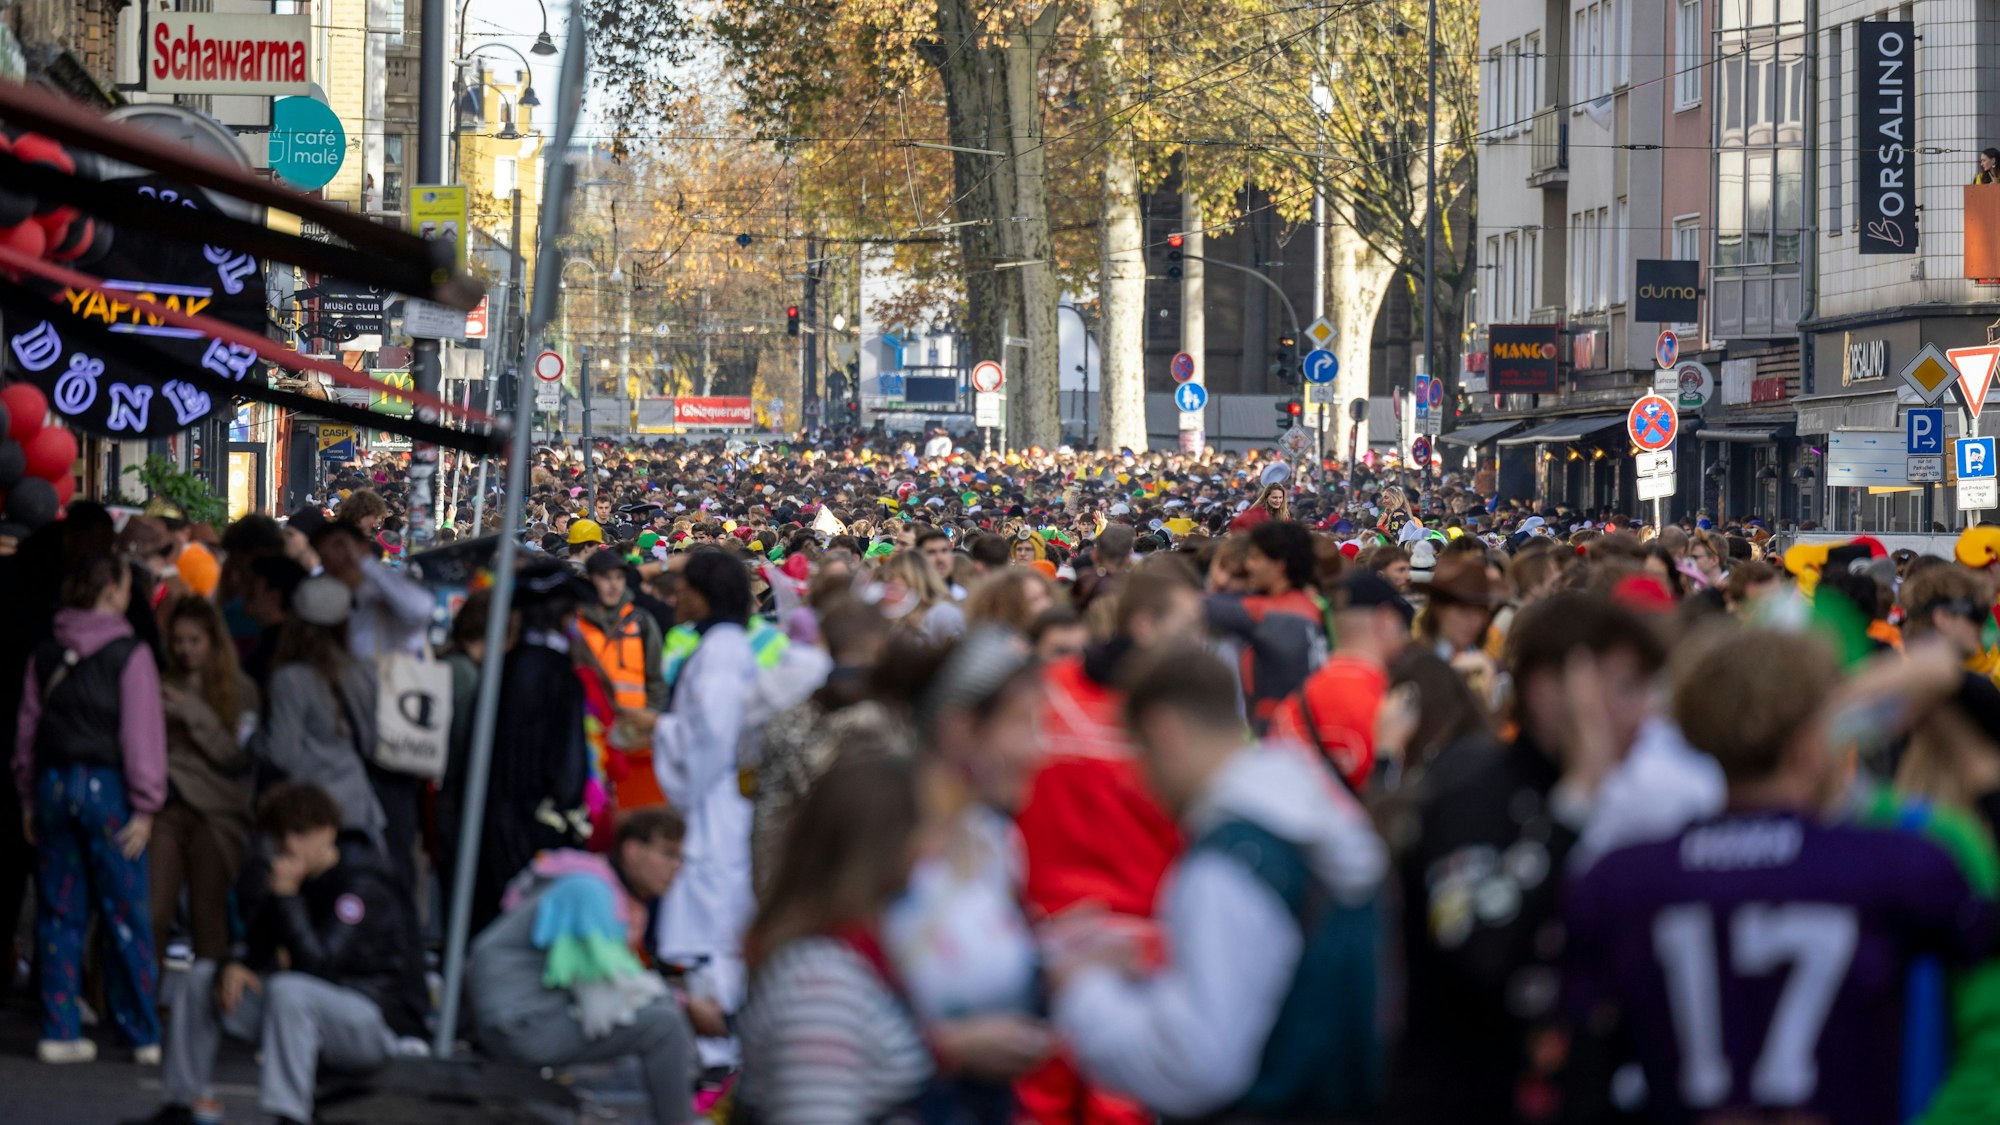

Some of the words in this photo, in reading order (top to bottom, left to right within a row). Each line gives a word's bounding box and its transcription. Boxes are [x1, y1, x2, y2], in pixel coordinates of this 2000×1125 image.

[153, 22, 306, 82] Schawarma
[295, 129, 337, 146] café
[1866, 31, 1905, 247] BORSALINO
[294, 149, 339, 165] malé
[1639, 283, 1697, 300] duma
[356, 303, 380, 312] CLUB
[322, 428, 349, 437] CASH
[1913, 414, 1932, 449] P
[1964, 442, 1987, 474] P
[1652, 900, 1861, 1108] 17
